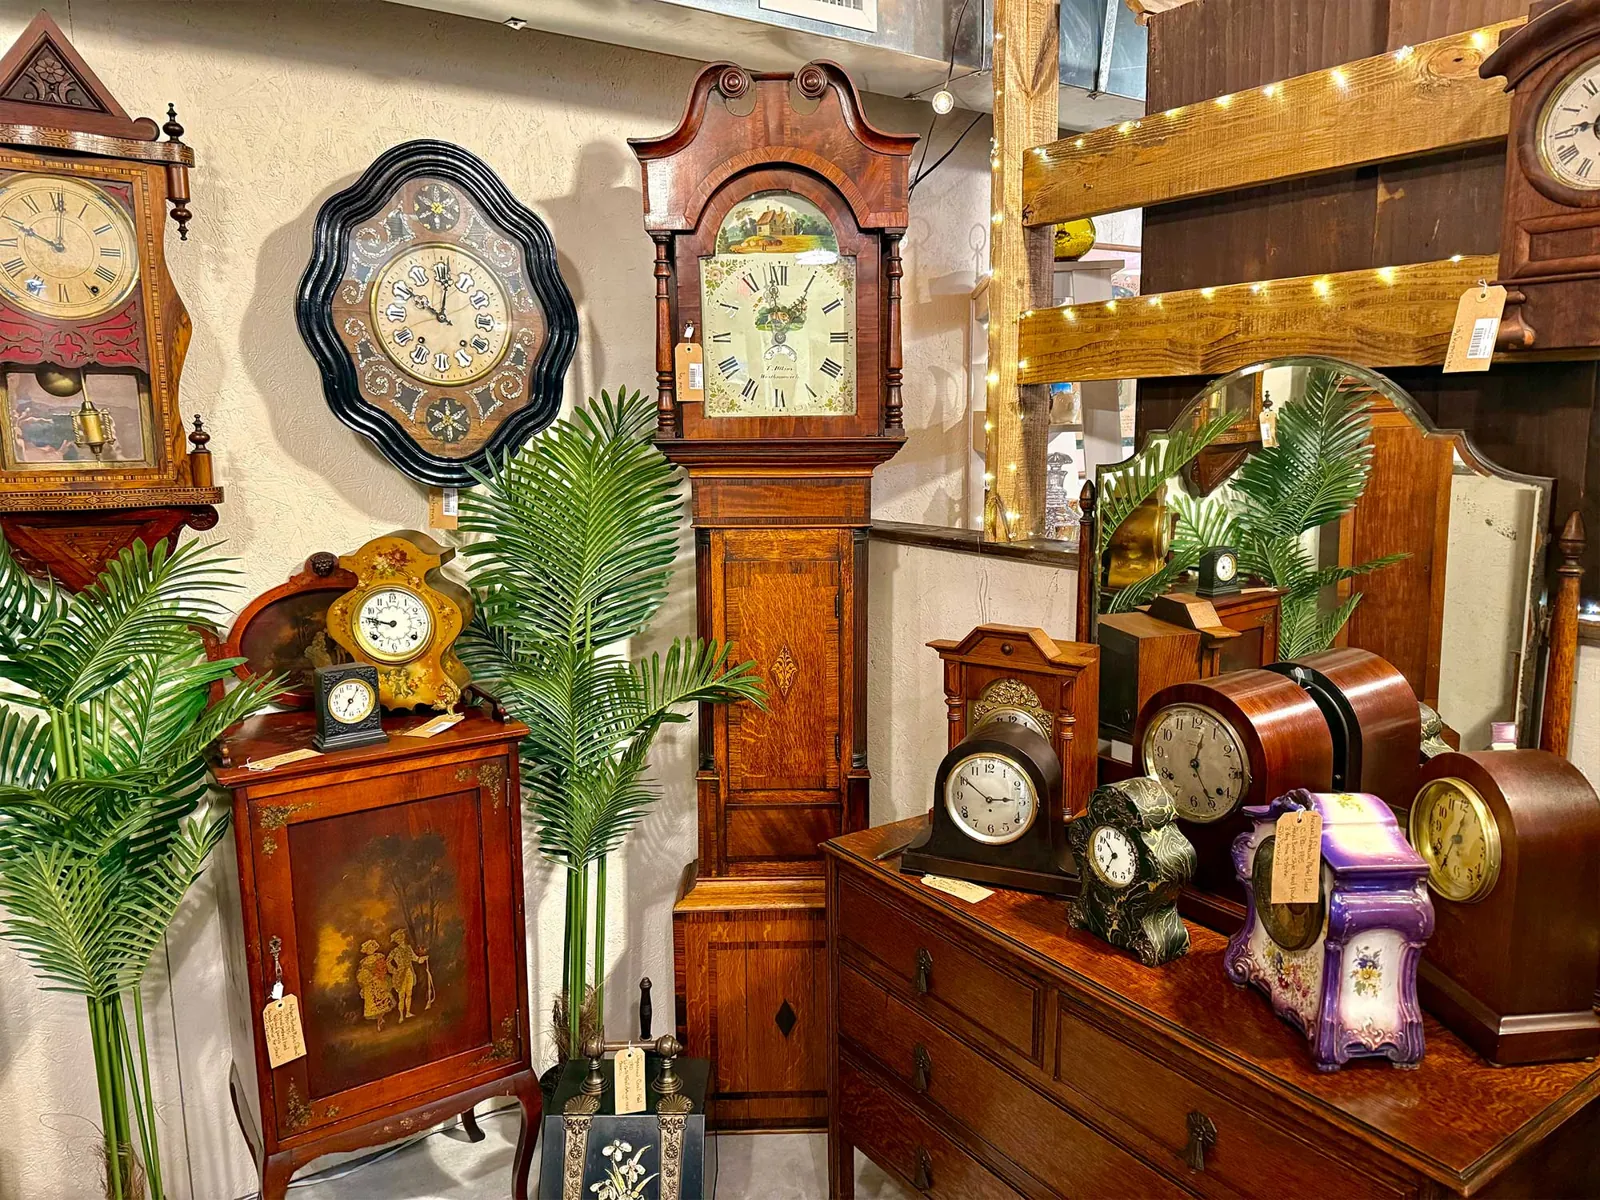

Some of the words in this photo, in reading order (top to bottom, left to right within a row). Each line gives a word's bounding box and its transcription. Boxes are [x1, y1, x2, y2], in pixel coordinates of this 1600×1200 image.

[92, 222, 113, 236] II
[100, 247, 121, 258] III
[742, 272, 761, 293] XI
[57, 282, 71, 303] VI
[821, 298, 842, 315] II
[829, 331, 850, 344] III
[718, 356, 741, 380] VIII
[819, 356, 843, 380] IIII
[740, 377, 760, 402] VII
[773, 387, 786, 408] VI
[1175, 717, 1184, 731] 11
[1191, 716, 1203, 730] 12
[1162, 728, 1173, 742] 10
[1156, 745, 1164, 758] 9
[1223, 744, 1232, 758] 2
[971, 766, 979, 776] 11
[984, 763, 995, 774] 12
[1161, 767, 1170, 780] 8
[1013, 780, 1021, 791] 2
[1173, 784, 1181, 797] 7
[956, 791, 964, 801] 9
[1224, 786, 1231, 799] 4
[1190, 795, 1198, 808] 6
[1448, 798, 1455, 811] 11
[1439, 805, 1447, 819] 10
[972, 818, 979, 828] 7
[987, 824, 995, 834] 6
[1002, 822, 1010, 832] 5
[1436, 819, 1442, 832] 9
[1105, 831, 1111, 840] 11
